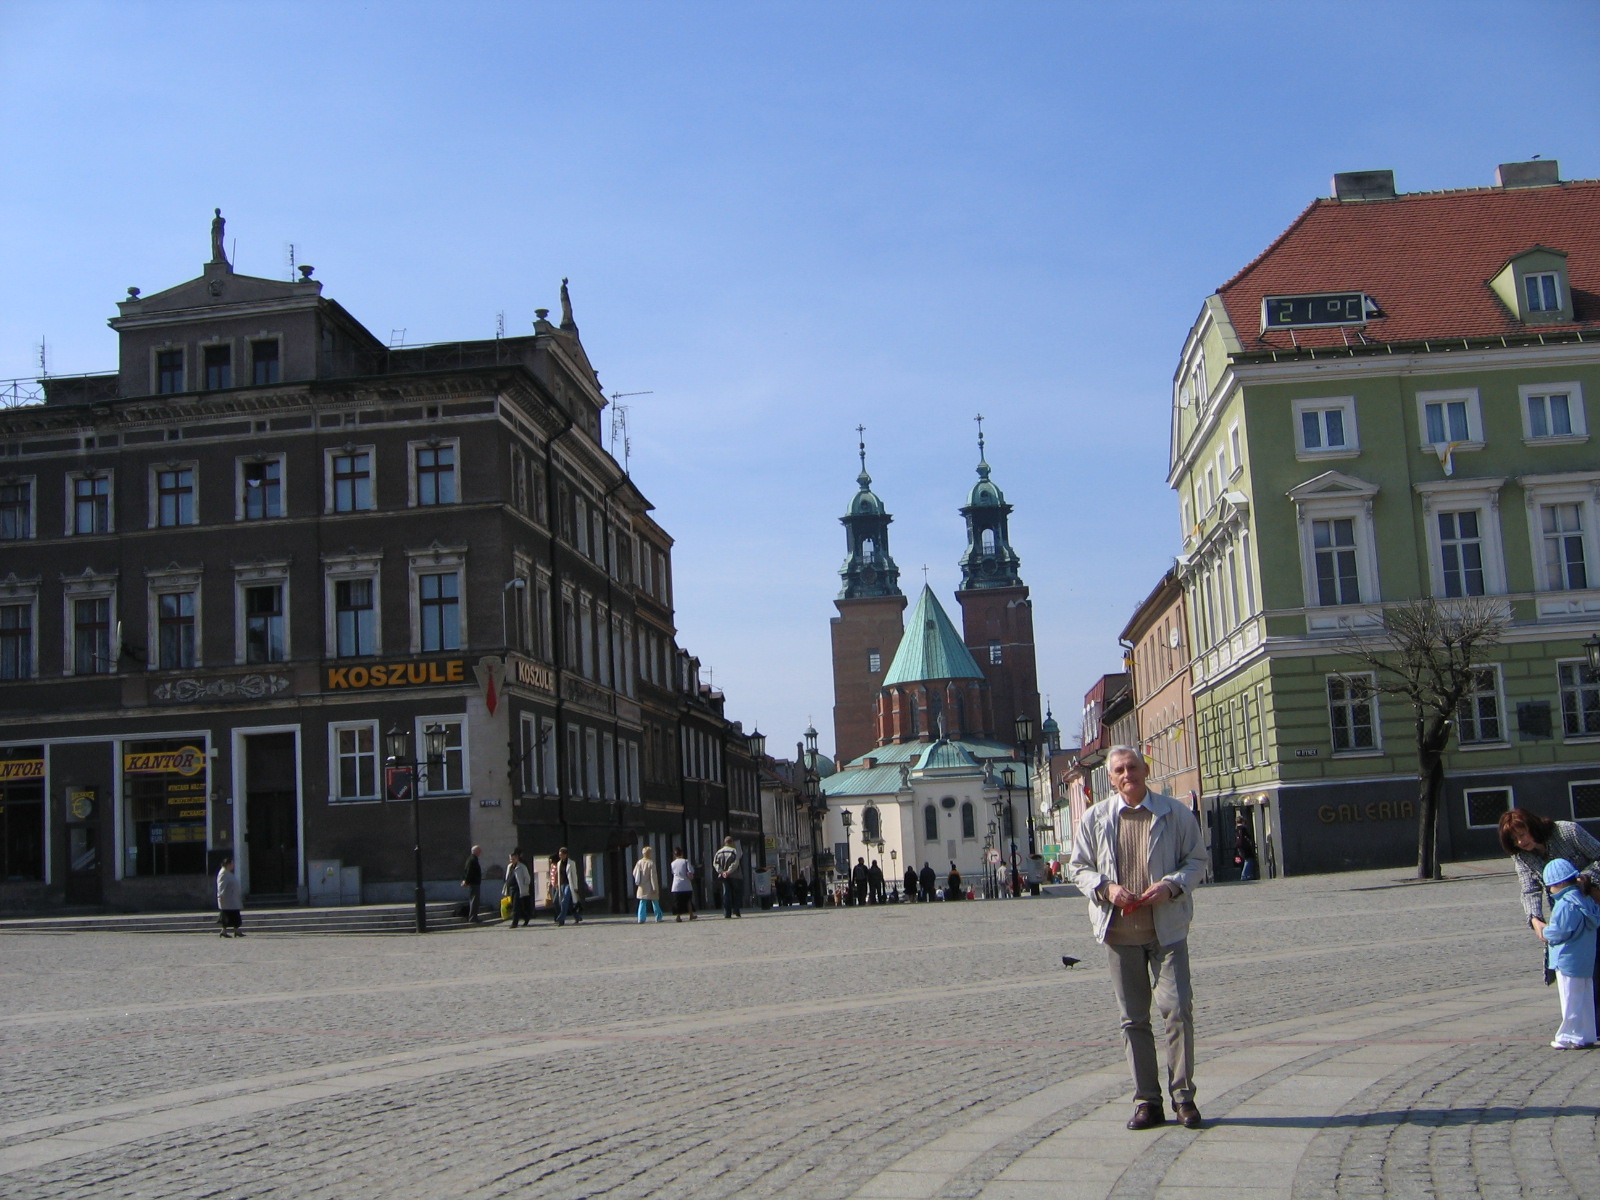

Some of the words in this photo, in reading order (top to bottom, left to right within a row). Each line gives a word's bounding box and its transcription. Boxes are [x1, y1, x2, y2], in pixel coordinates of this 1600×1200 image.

[328, 661, 464, 688] KOSZULE
[518, 661, 554, 691] KOSZULE
[0, 762, 43, 776] NTOR
[126, 754, 194, 771] KANTOR
[1318, 800, 1415, 824] GALERIA
